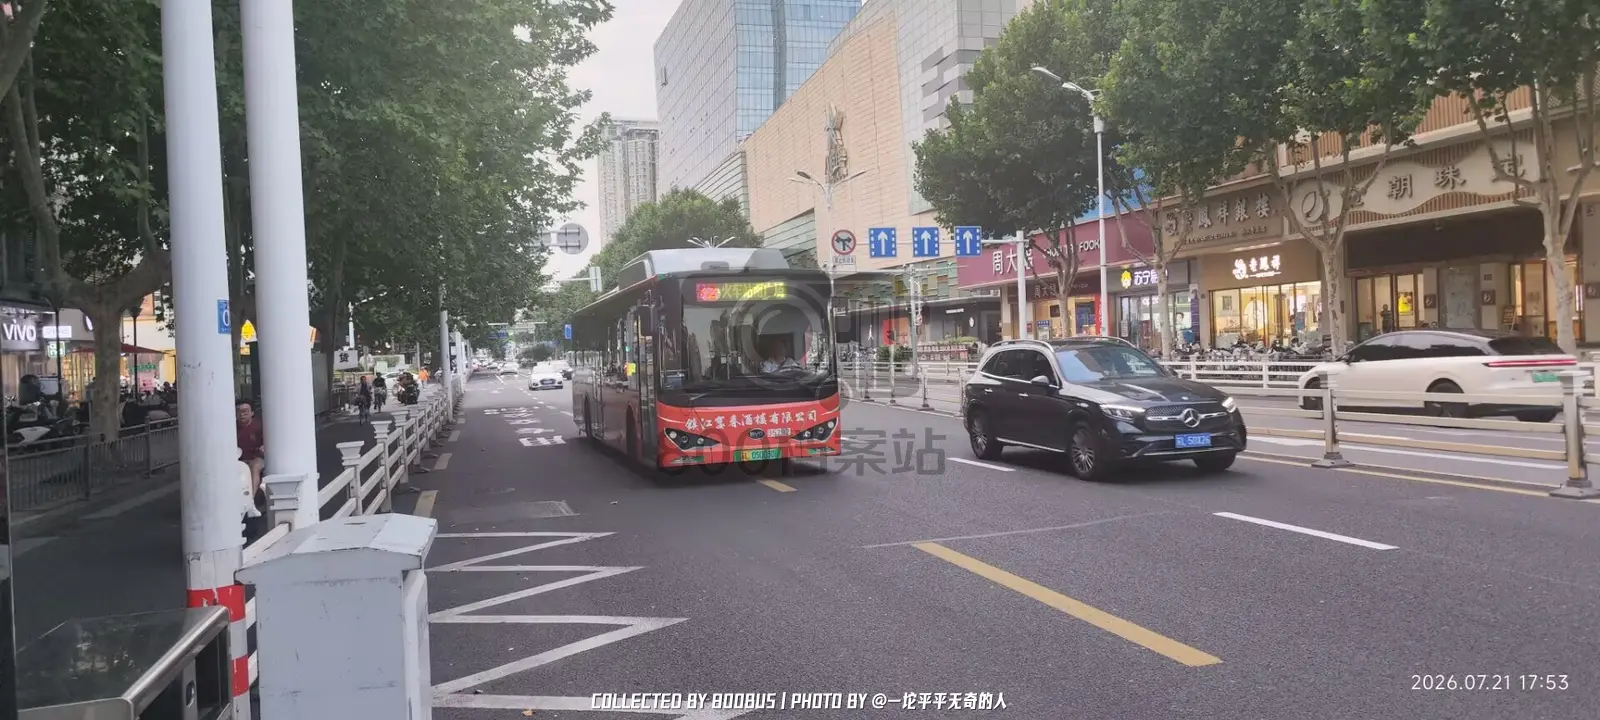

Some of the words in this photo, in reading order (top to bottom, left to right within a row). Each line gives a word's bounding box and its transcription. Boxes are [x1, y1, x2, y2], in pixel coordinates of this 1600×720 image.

[1133, 269, 1168, 286] 苏宁易
[2, 318, 37, 342] vivo
